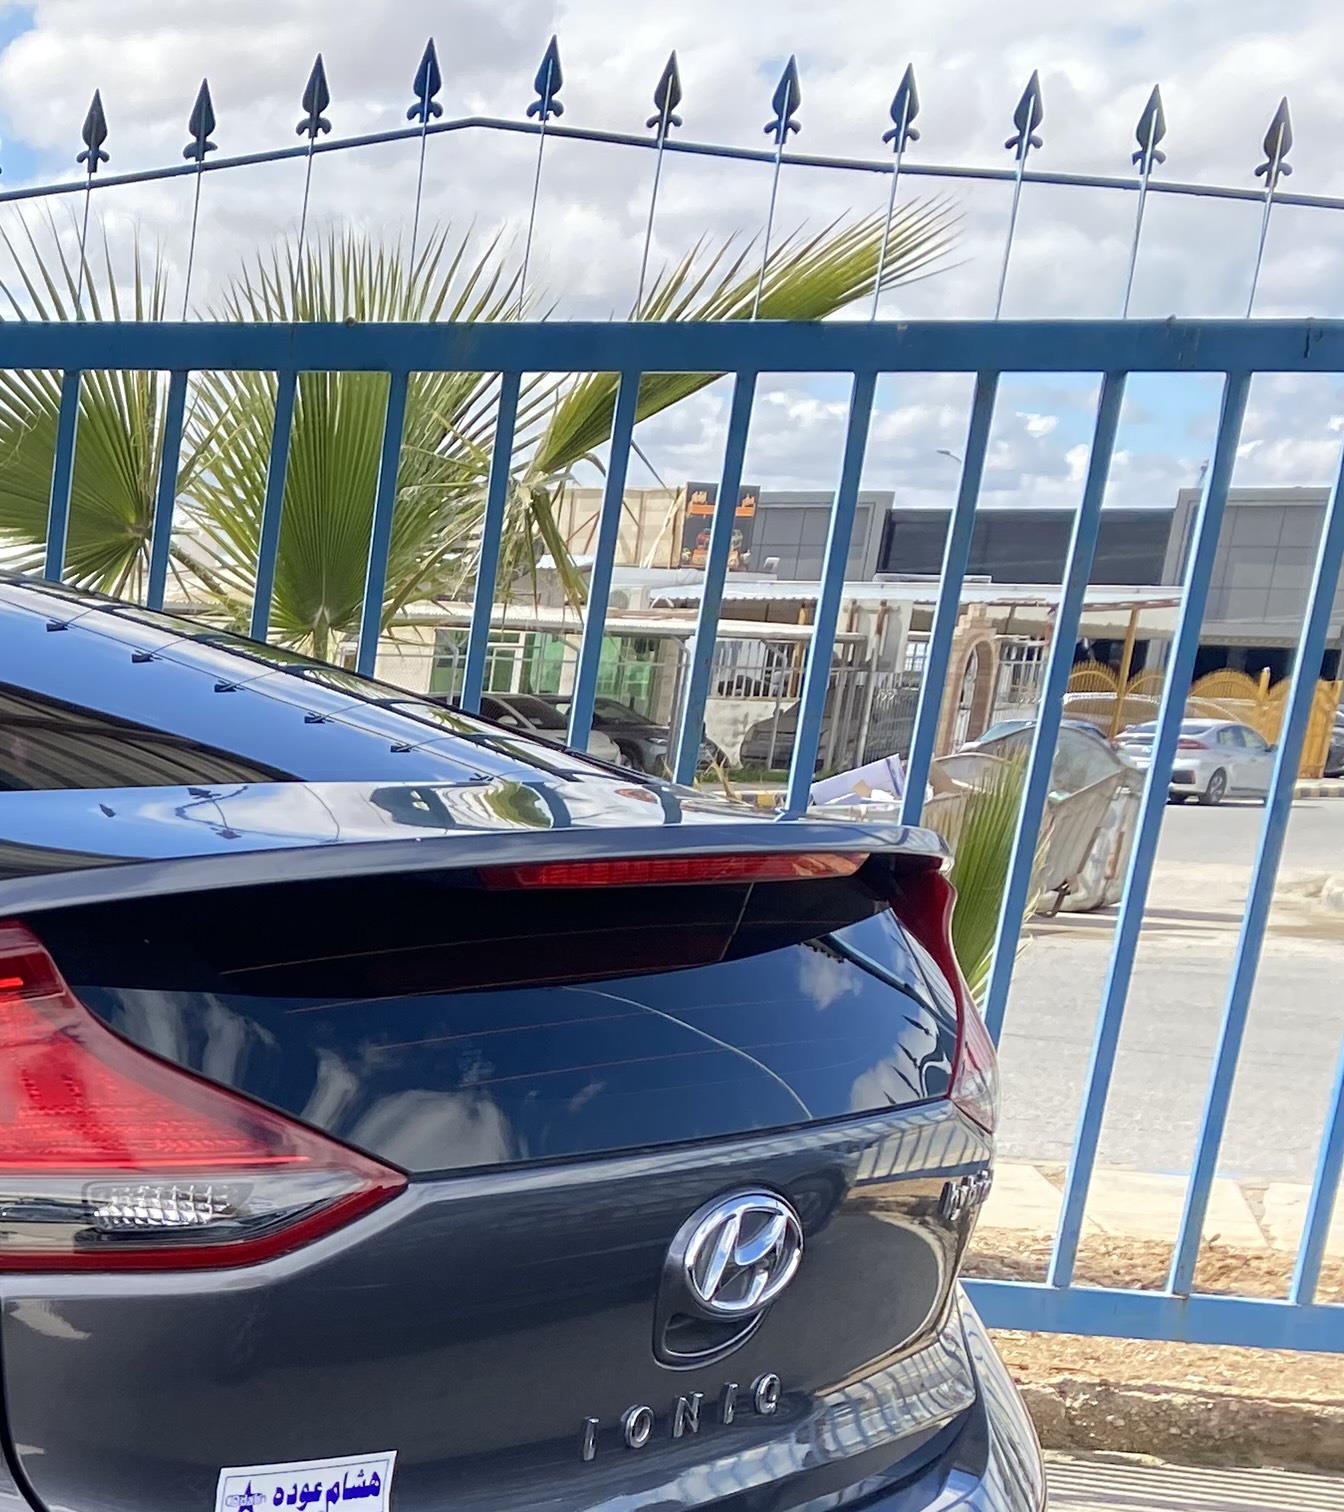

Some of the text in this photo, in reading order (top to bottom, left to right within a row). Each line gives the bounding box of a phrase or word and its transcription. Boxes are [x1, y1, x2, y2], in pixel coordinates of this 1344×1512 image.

[583, 1372, 782, 1461] IONIQ
[272, 1468, 381, 1512] هشام عوده
